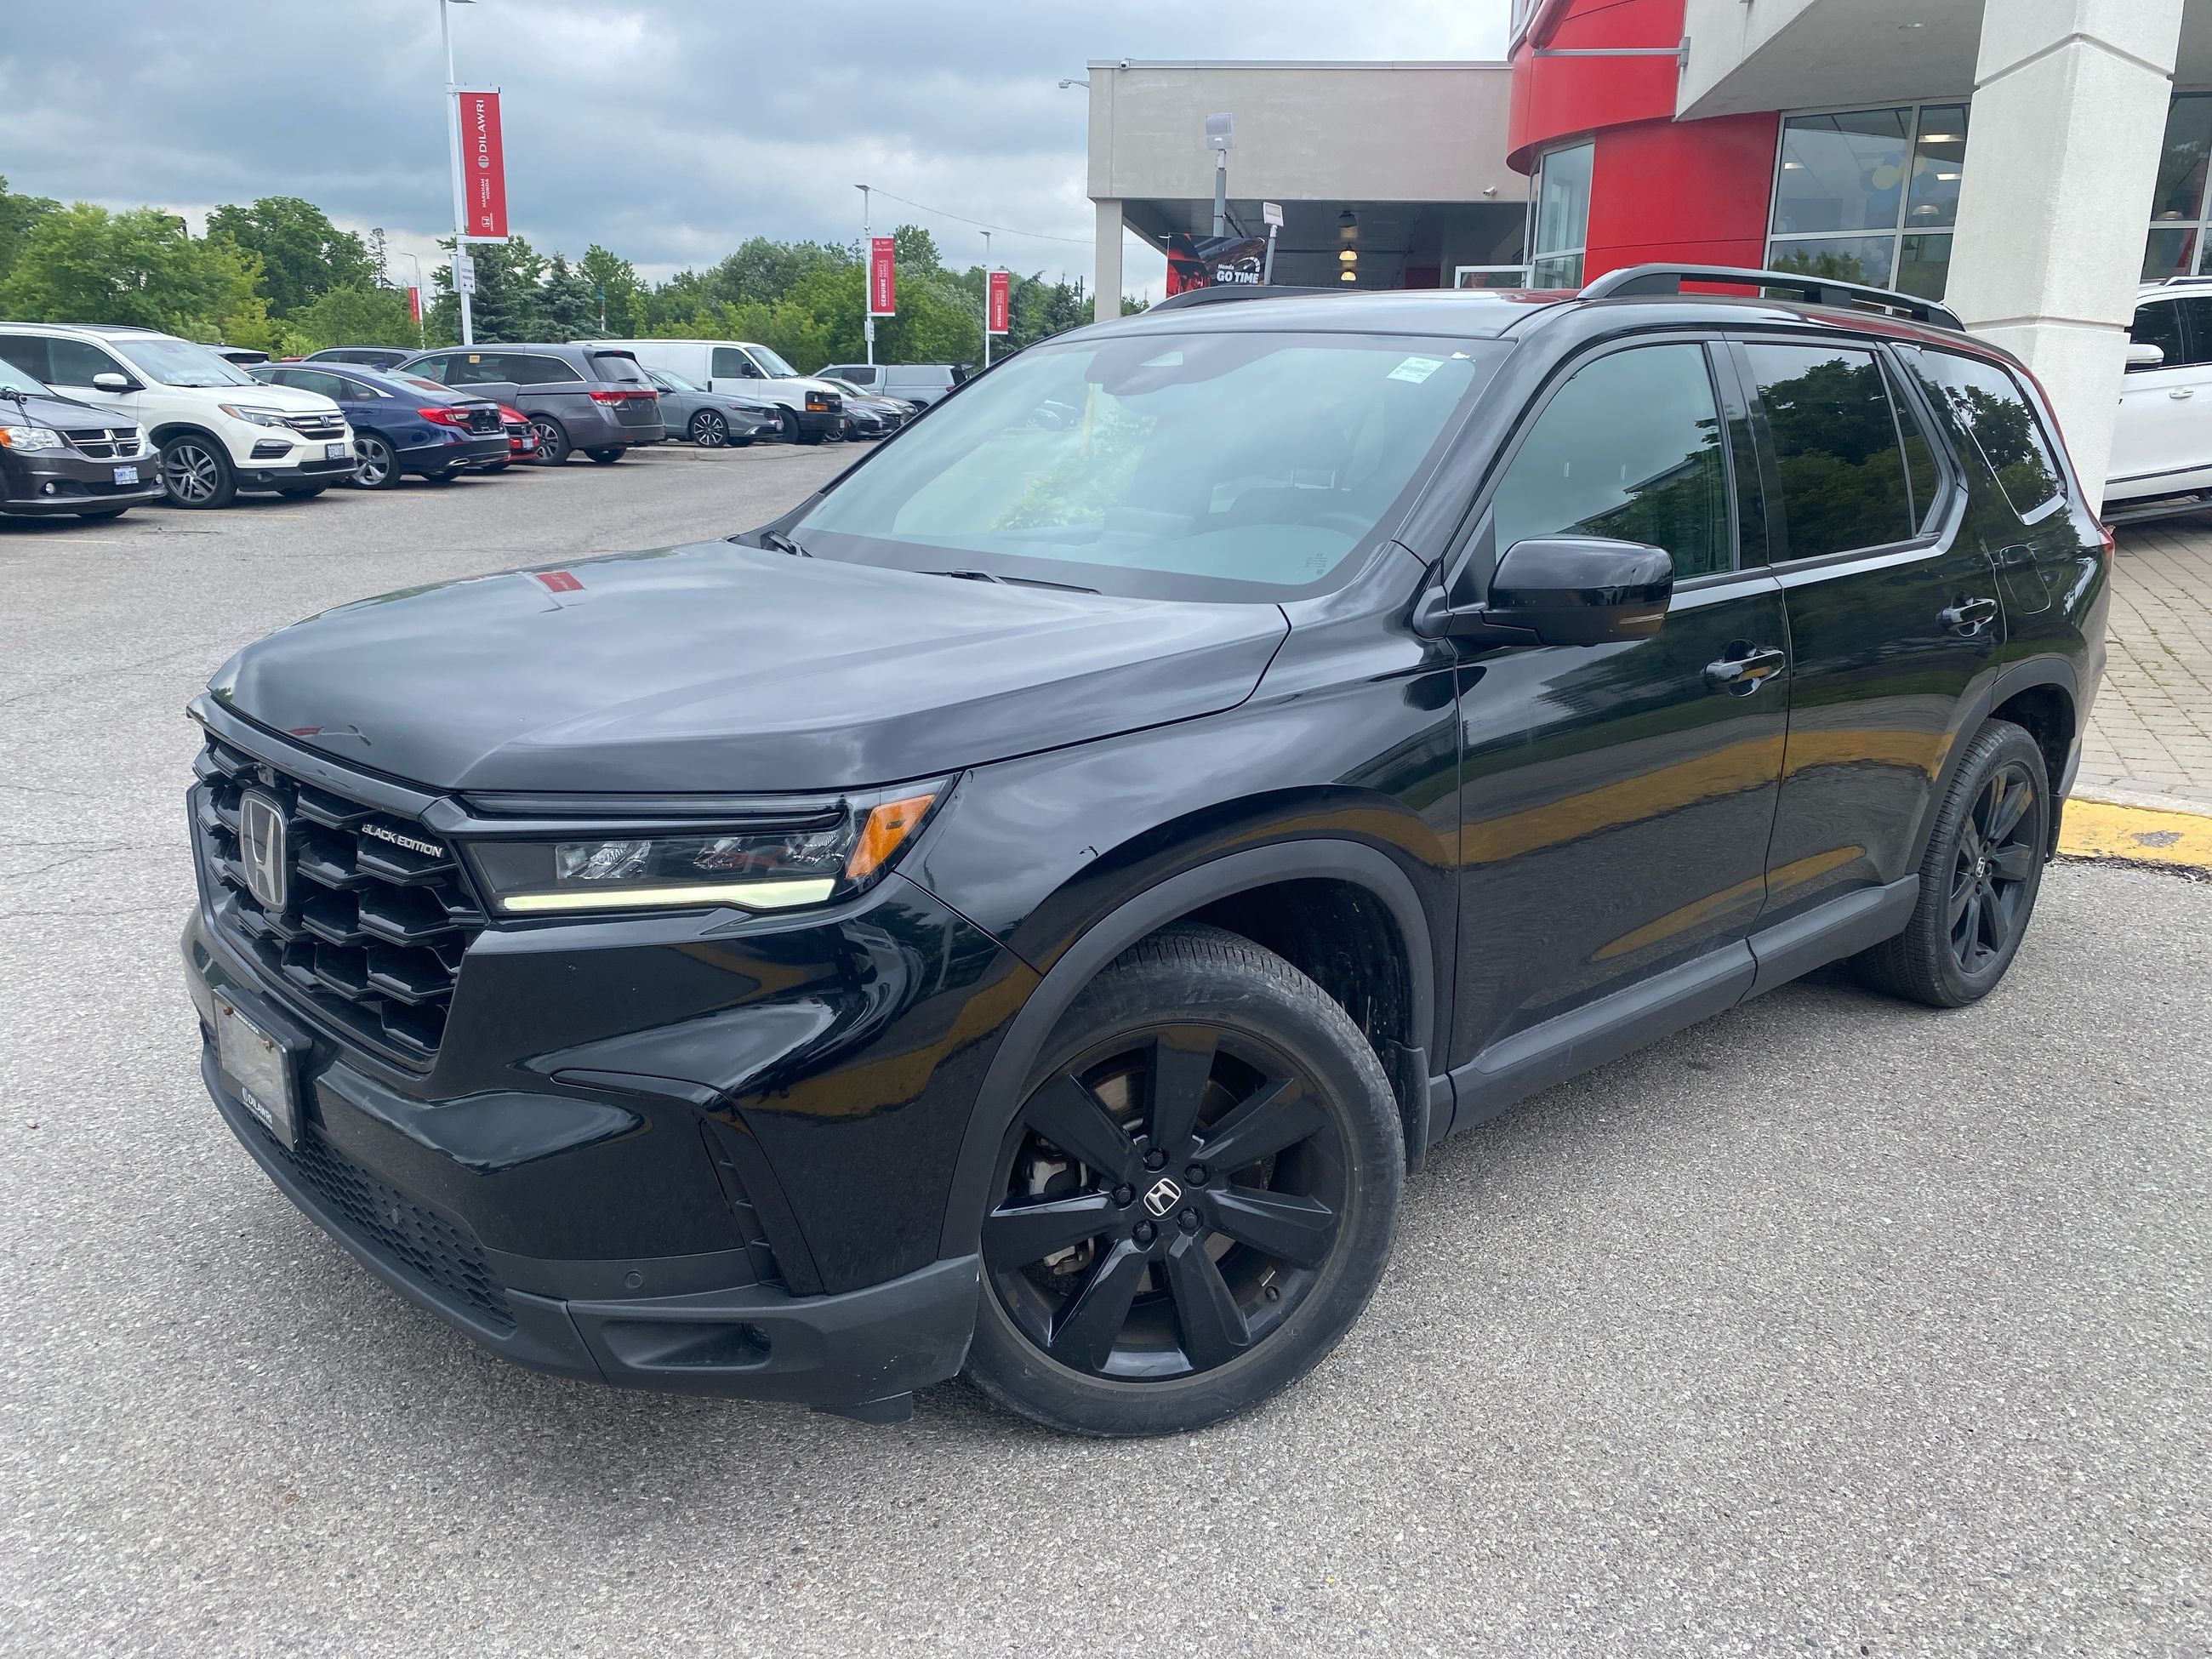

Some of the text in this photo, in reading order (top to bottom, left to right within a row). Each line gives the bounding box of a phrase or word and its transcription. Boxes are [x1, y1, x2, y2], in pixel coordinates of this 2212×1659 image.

[476, 99, 487, 152] DILAWRI
[1217, 271, 1259, 284] GO TIME
[362, 824, 442, 858] BLACK EDITION
[248, 1093, 272, 1125] DILAWRI
